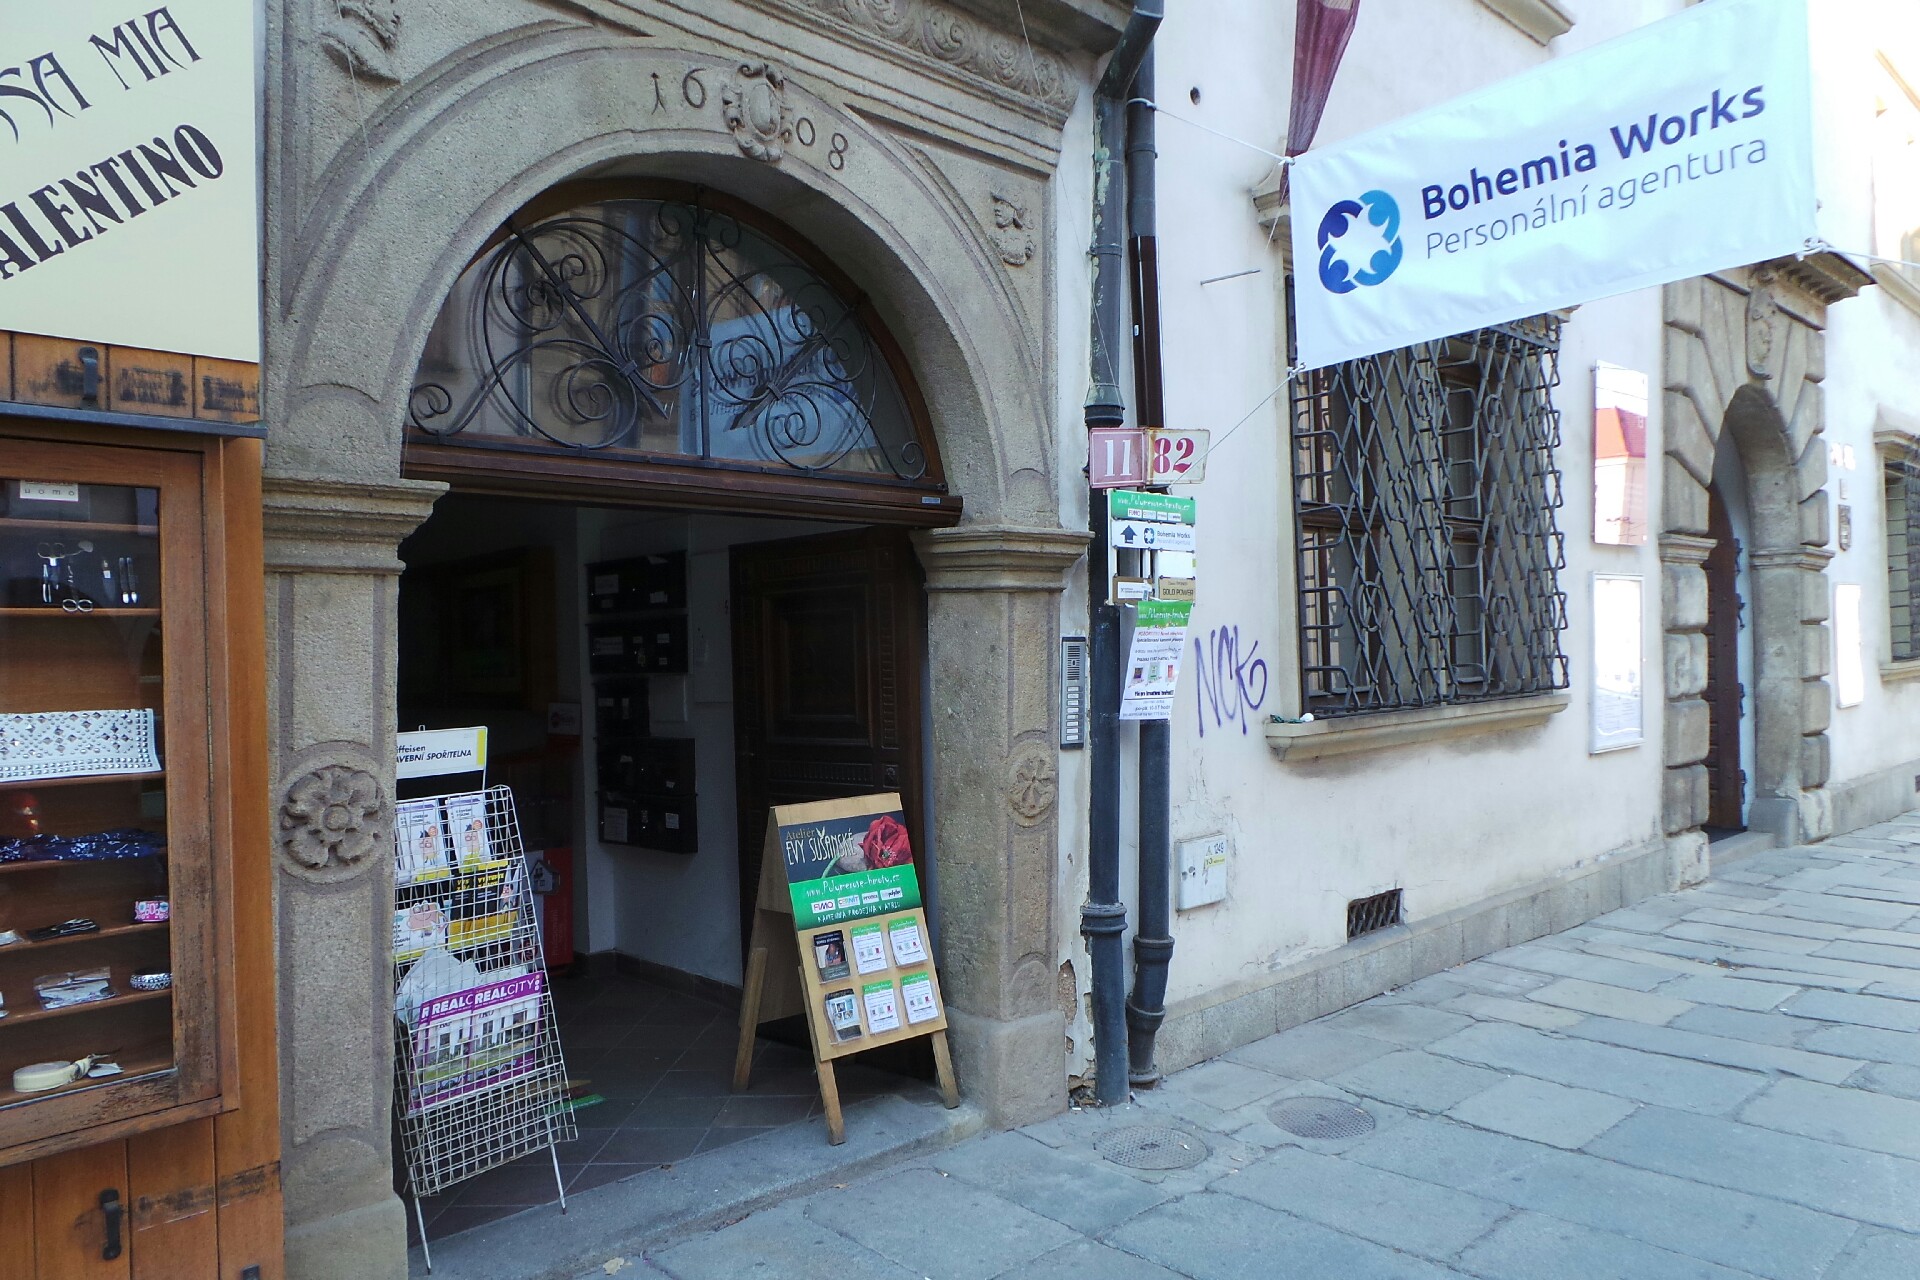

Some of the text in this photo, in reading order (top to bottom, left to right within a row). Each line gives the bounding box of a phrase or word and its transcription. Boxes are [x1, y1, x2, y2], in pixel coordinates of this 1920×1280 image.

[88, 6, 202, 90] MIA
[1421, 84, 1767, 220] Bohemia Works
[1425, 138, 1767, 259] Personální agentura
[1104, 438, 1132, 477] 11
[1153, 437, 1194, 474] 82
[1156, 530, 1191, 539] Bohemia Works
[1163, 588, 1175, 596] GOLD
[426, 750, 472, 760] SPOŘITELNA
[785, 840, 806, 865] EVY
[813, 901, 834, 911] FIMO
[474, 978, 534, 1004] REALCITY
